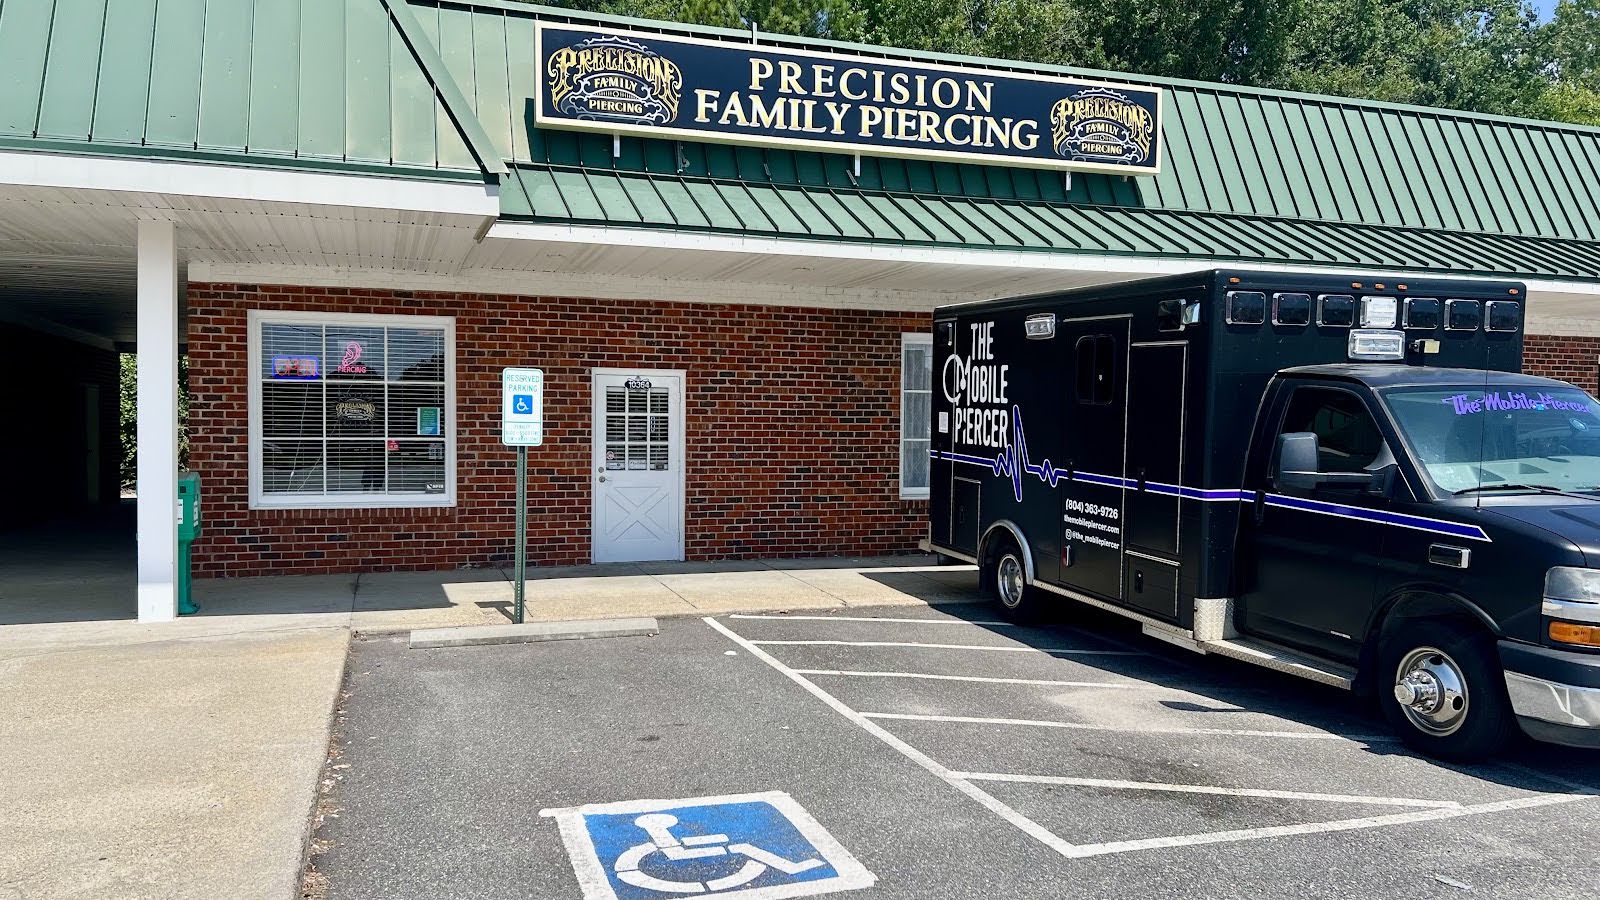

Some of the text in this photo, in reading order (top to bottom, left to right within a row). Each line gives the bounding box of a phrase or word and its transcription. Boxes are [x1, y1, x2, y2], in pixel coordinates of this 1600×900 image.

[548, 46, 682, 122] PRECISION
[594, 76, 638, 92] FAMILY
[748, 57, 995, 113] PRECISION
[588, 99, 643, 114] PIERCING
[694, 88, 1040, 150] FAMILY PIERCING
[1050, 97, 1154, 161] PRECISION
[1085, 122, 1120, 136] FAMILY
[1081, 142, 1123, 155] PIERCING
[970, 321, 995, 360] THE
[337, 365, 367, 374] PIERCING
[506, 374, 540, 383] RESERVED
[942, 353, 1009, 407] MOBILE
[508, 384, 538, 393] PARKING
[628, 380, 650, 389] 10364
[1442, 393, 1482, 415] The
[1478, 391, 1537, 412] Mobile
[954, 407, 1009, 448] PIERCER
[1065, 498, 1119, 520] (804) 363-9726
[1063, 514, 1120, 535] themobilepiercer.com
